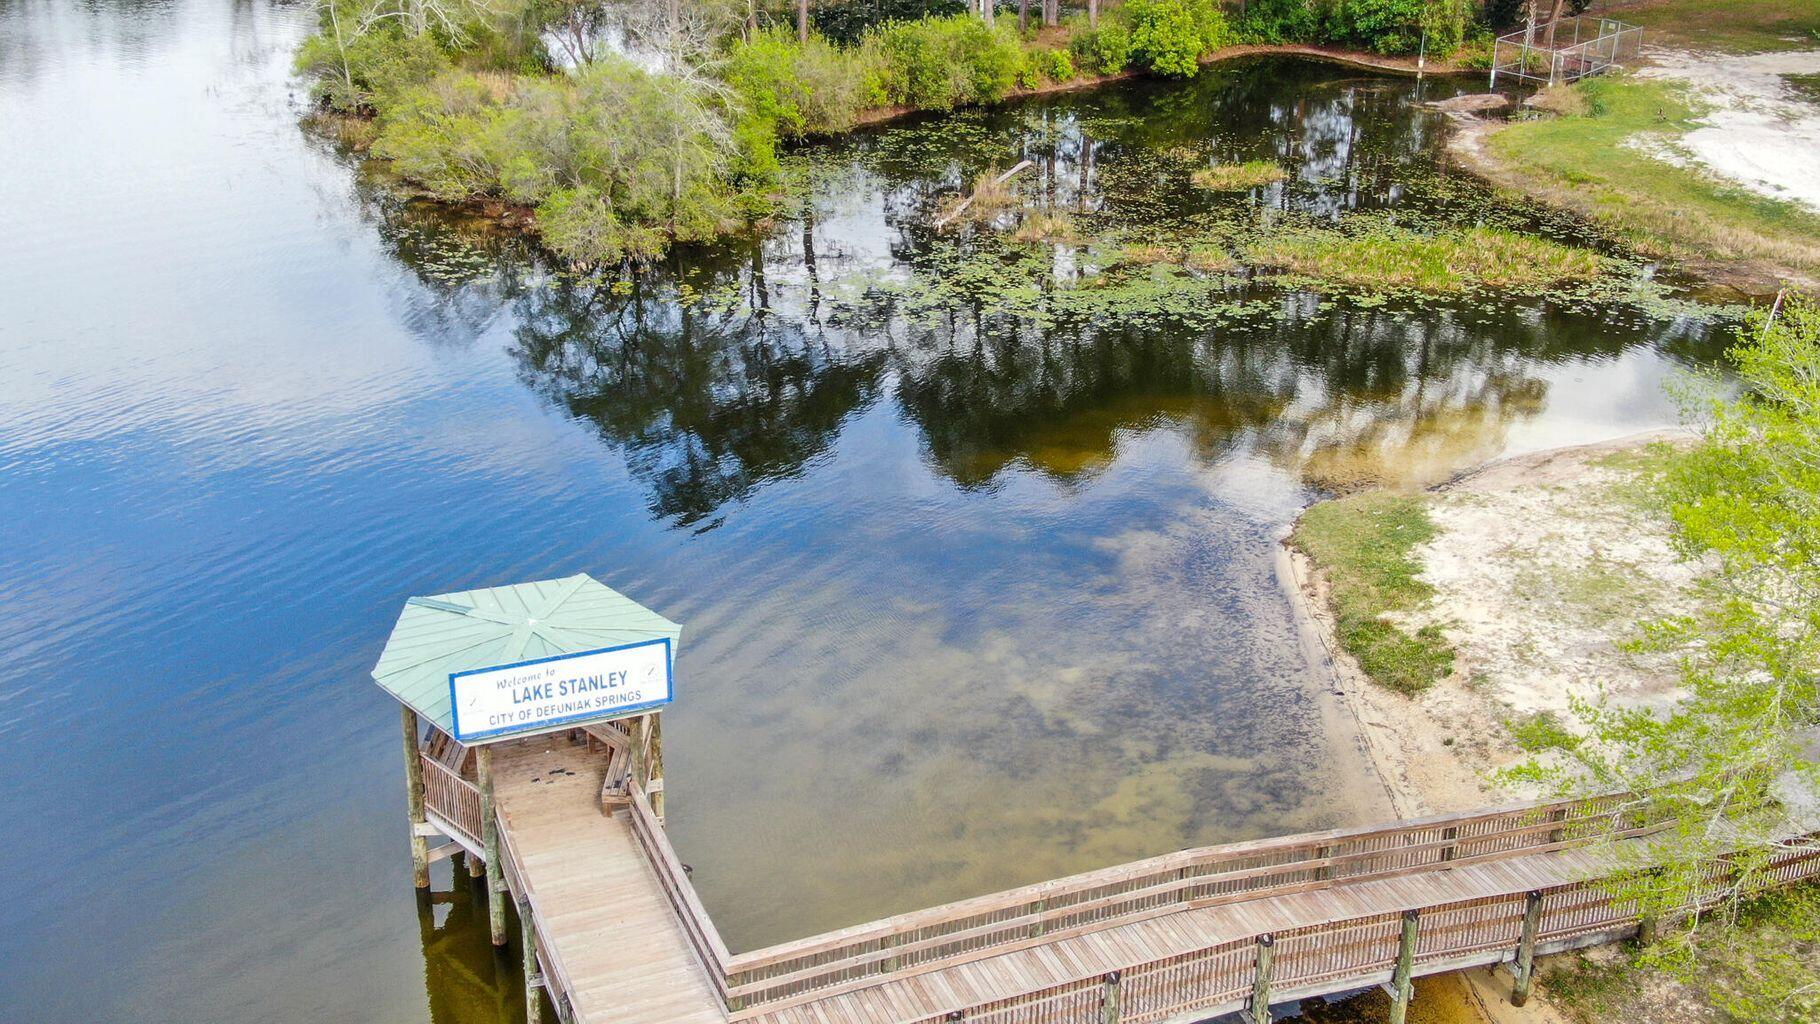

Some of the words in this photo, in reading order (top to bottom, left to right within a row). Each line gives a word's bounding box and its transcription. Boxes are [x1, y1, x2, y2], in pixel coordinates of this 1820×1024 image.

[496, 672, 542, 690] Welcome
[512, 682, 554, 705] LAKE
[558, 670, 628, 697] STANLEY
[489, 712, 514, 726] CITY
[518, 708, 533, 721] OF
[536, 699, 592, 718] DEFUNIAK
[595, 690, 642, 708] SPRINGS
